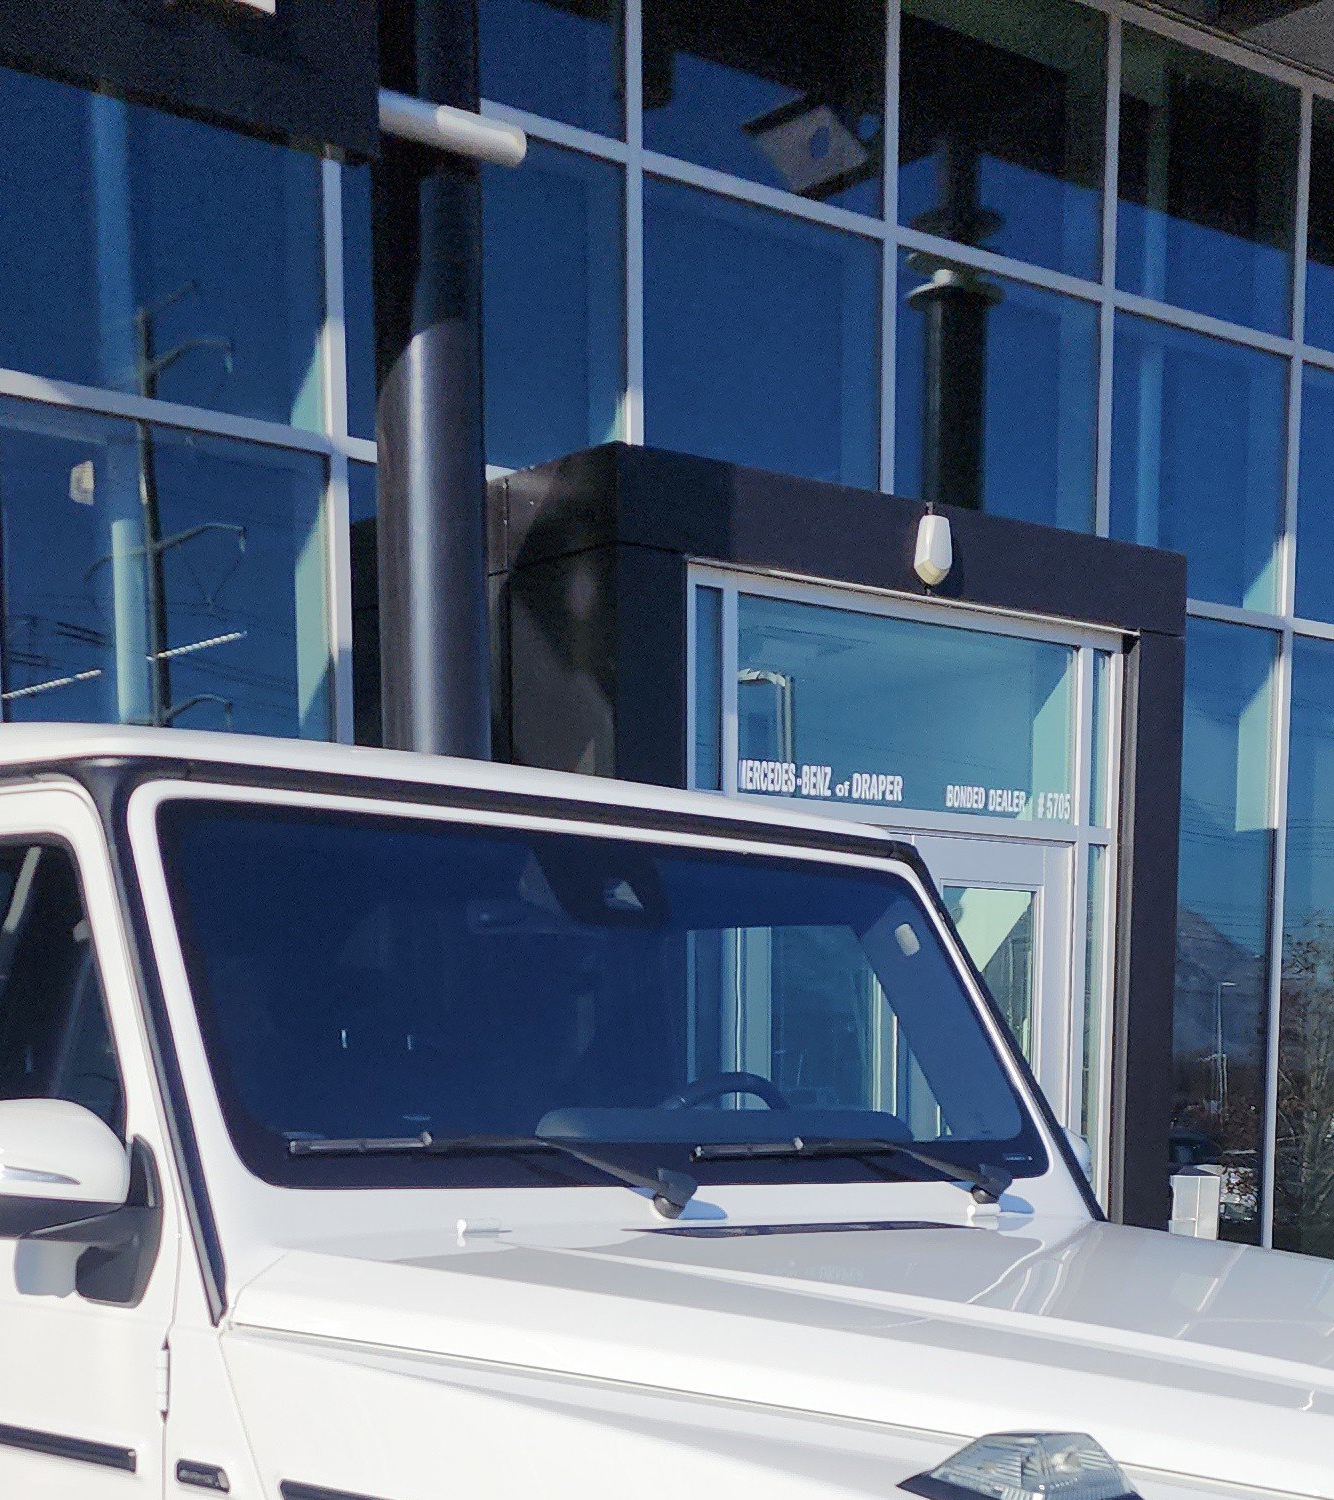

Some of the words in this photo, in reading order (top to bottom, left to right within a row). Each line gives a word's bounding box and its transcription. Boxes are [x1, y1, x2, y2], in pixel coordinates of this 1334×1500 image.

[835, 781, 850, 797] of
[851, 772, 903, 801] DRAPER
[946, 785, 985, 809] BONDED
[988, 789, 1027, 812] DEALER
